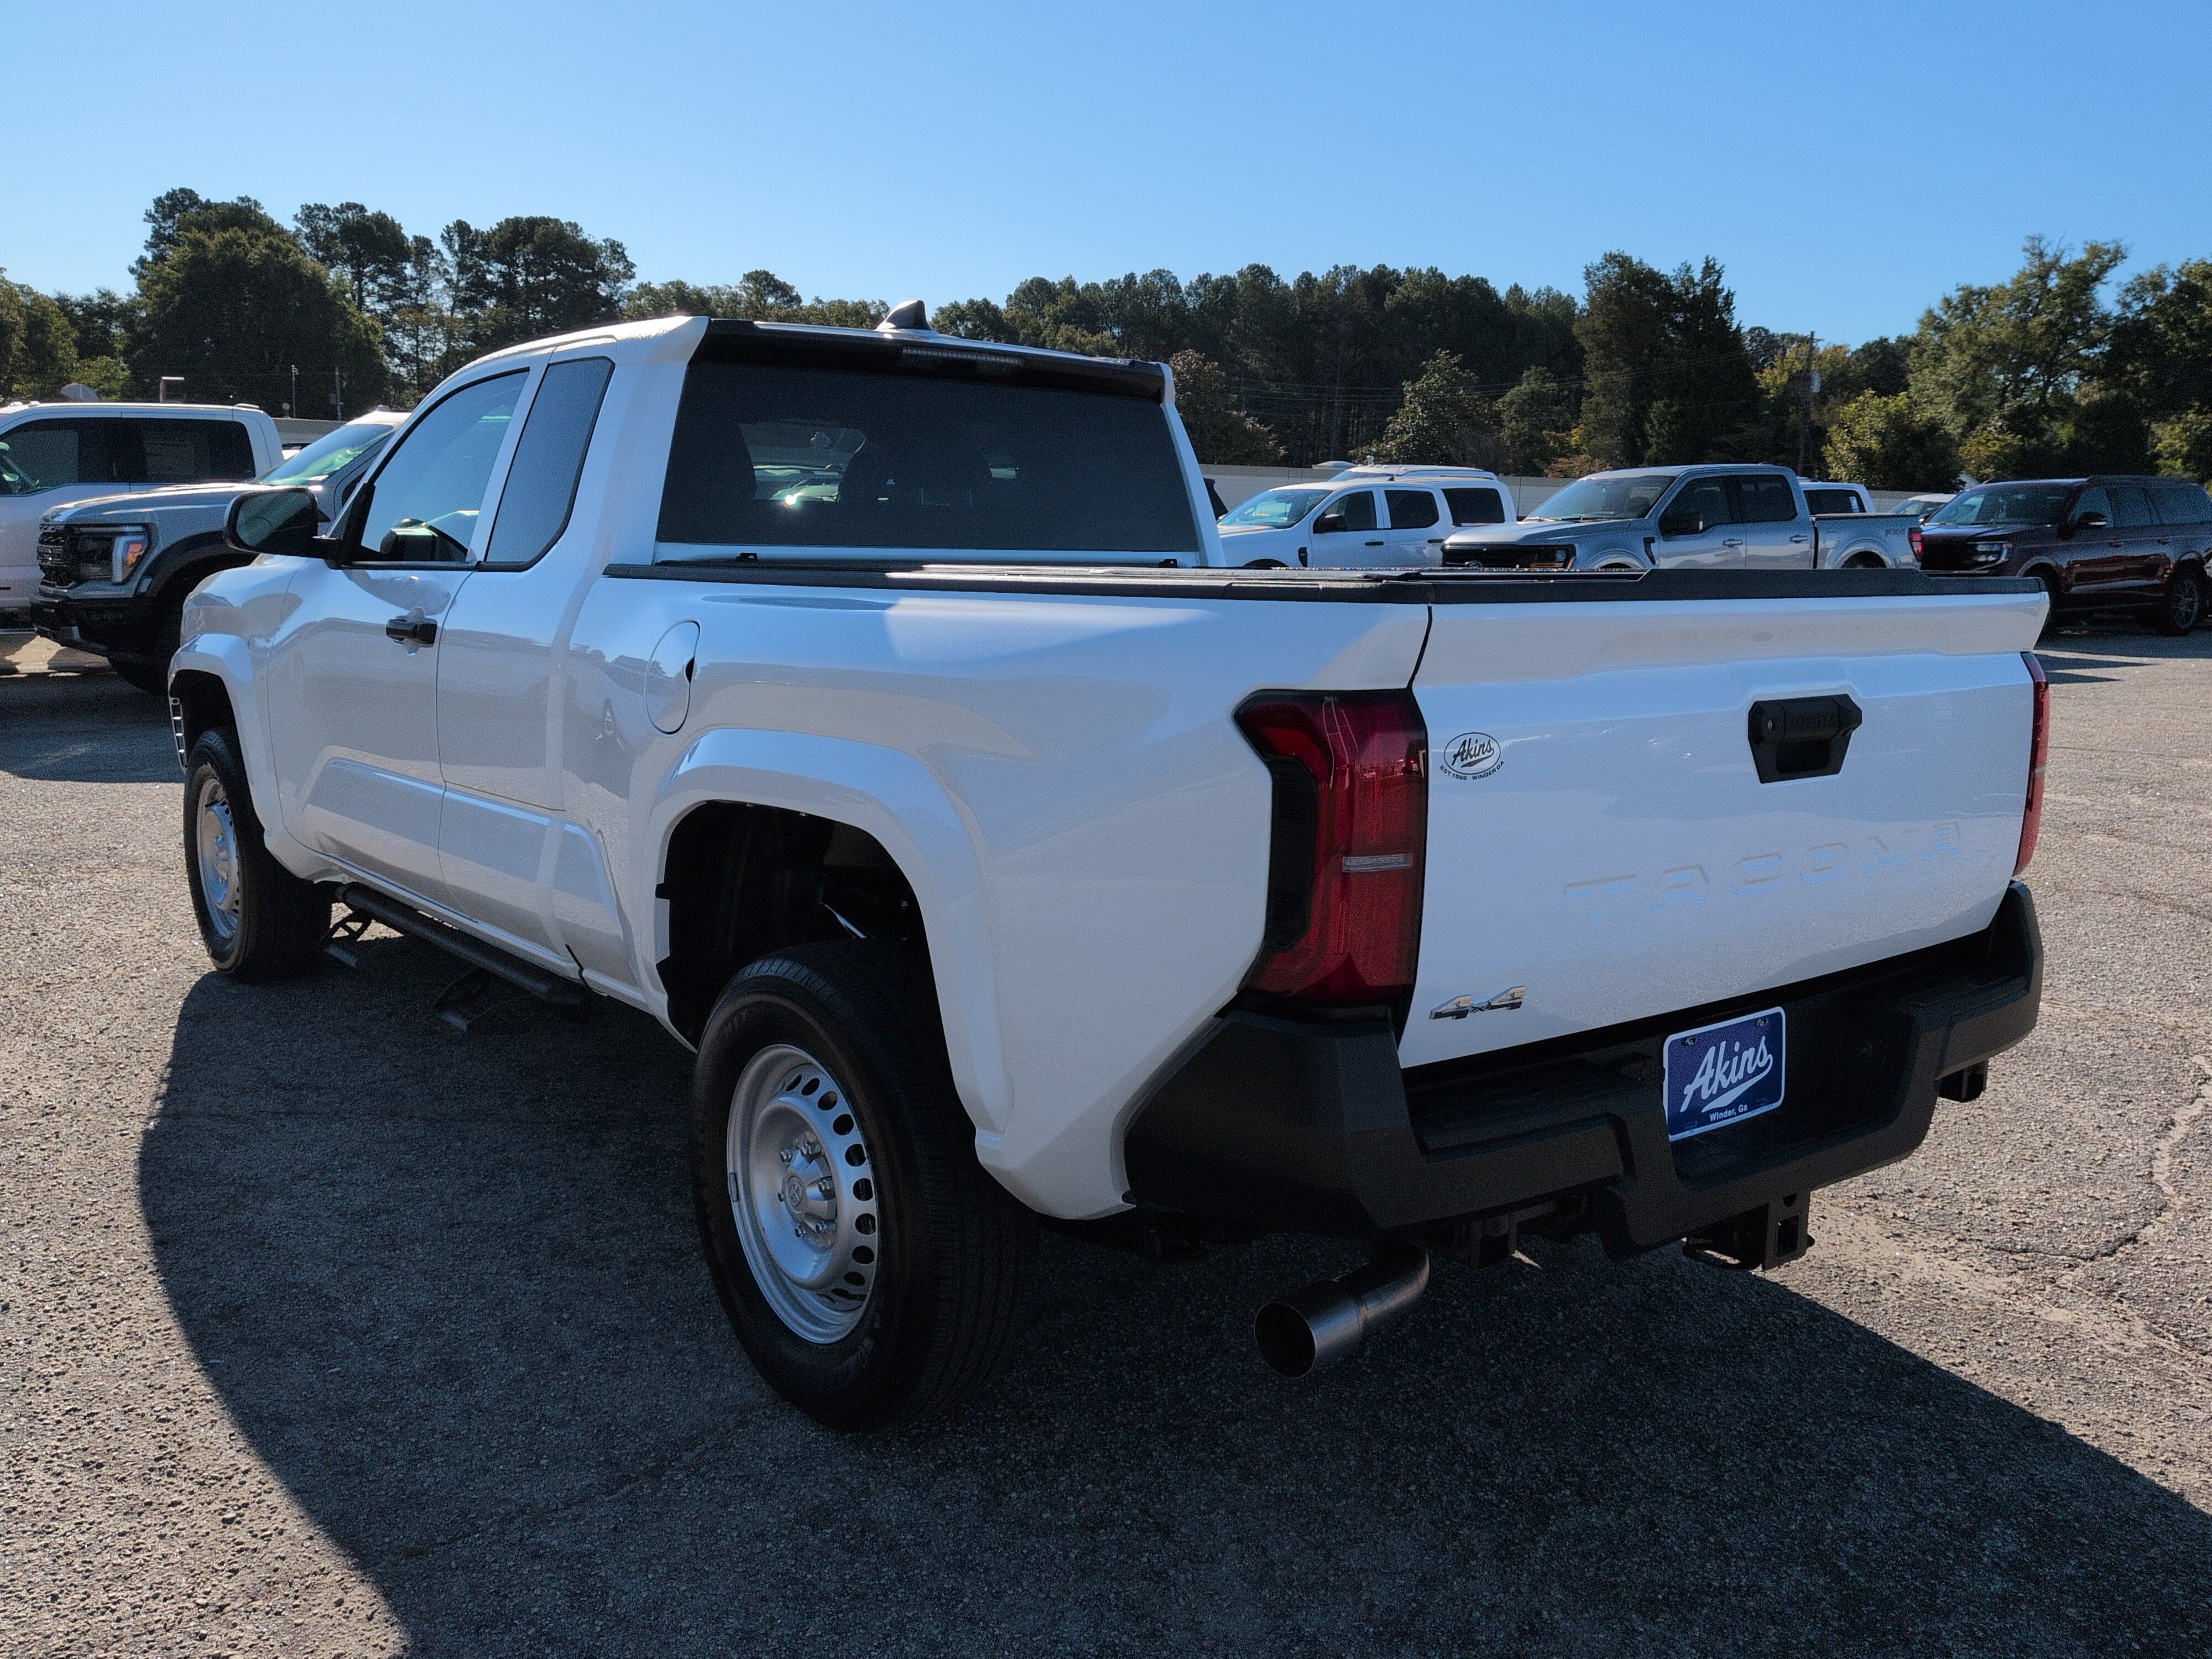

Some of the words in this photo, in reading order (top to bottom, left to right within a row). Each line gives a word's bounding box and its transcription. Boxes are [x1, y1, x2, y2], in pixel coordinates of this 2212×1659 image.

[1451, 738, 1494, 768] Akins
[1472, 768, 1496, 780] WINDER
[1564, 821, 1961, 920] TACOMA
[1680, 1035, 1773, 1113] Akins
[1709, 1108, 1737, 1121] Winder,
[1738, 1104, 1748, 1113] Ga
